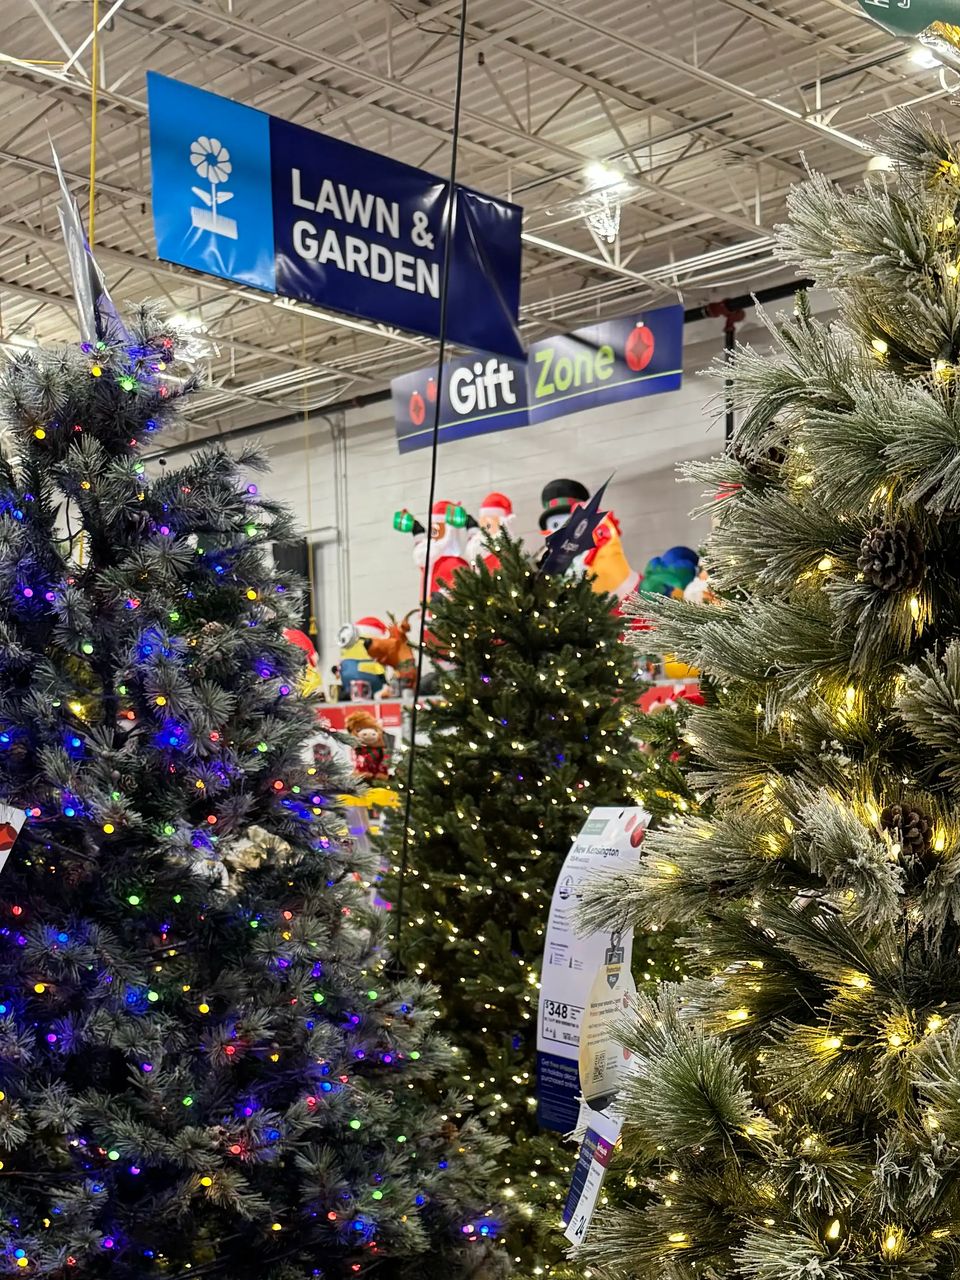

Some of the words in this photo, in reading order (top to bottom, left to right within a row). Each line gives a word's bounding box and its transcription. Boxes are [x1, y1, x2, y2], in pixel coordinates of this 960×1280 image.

[291, 167, 400, 239] LAWN
[410, 210, 435, 251] &
[292, 219, 440, 299] GARDEN
[449, 358, 517, 415] Gift
[534, 344, 616, 399] Zone
[586, 844, 620, 858] Kensington
[545, 1001, 568, 1019] $348
